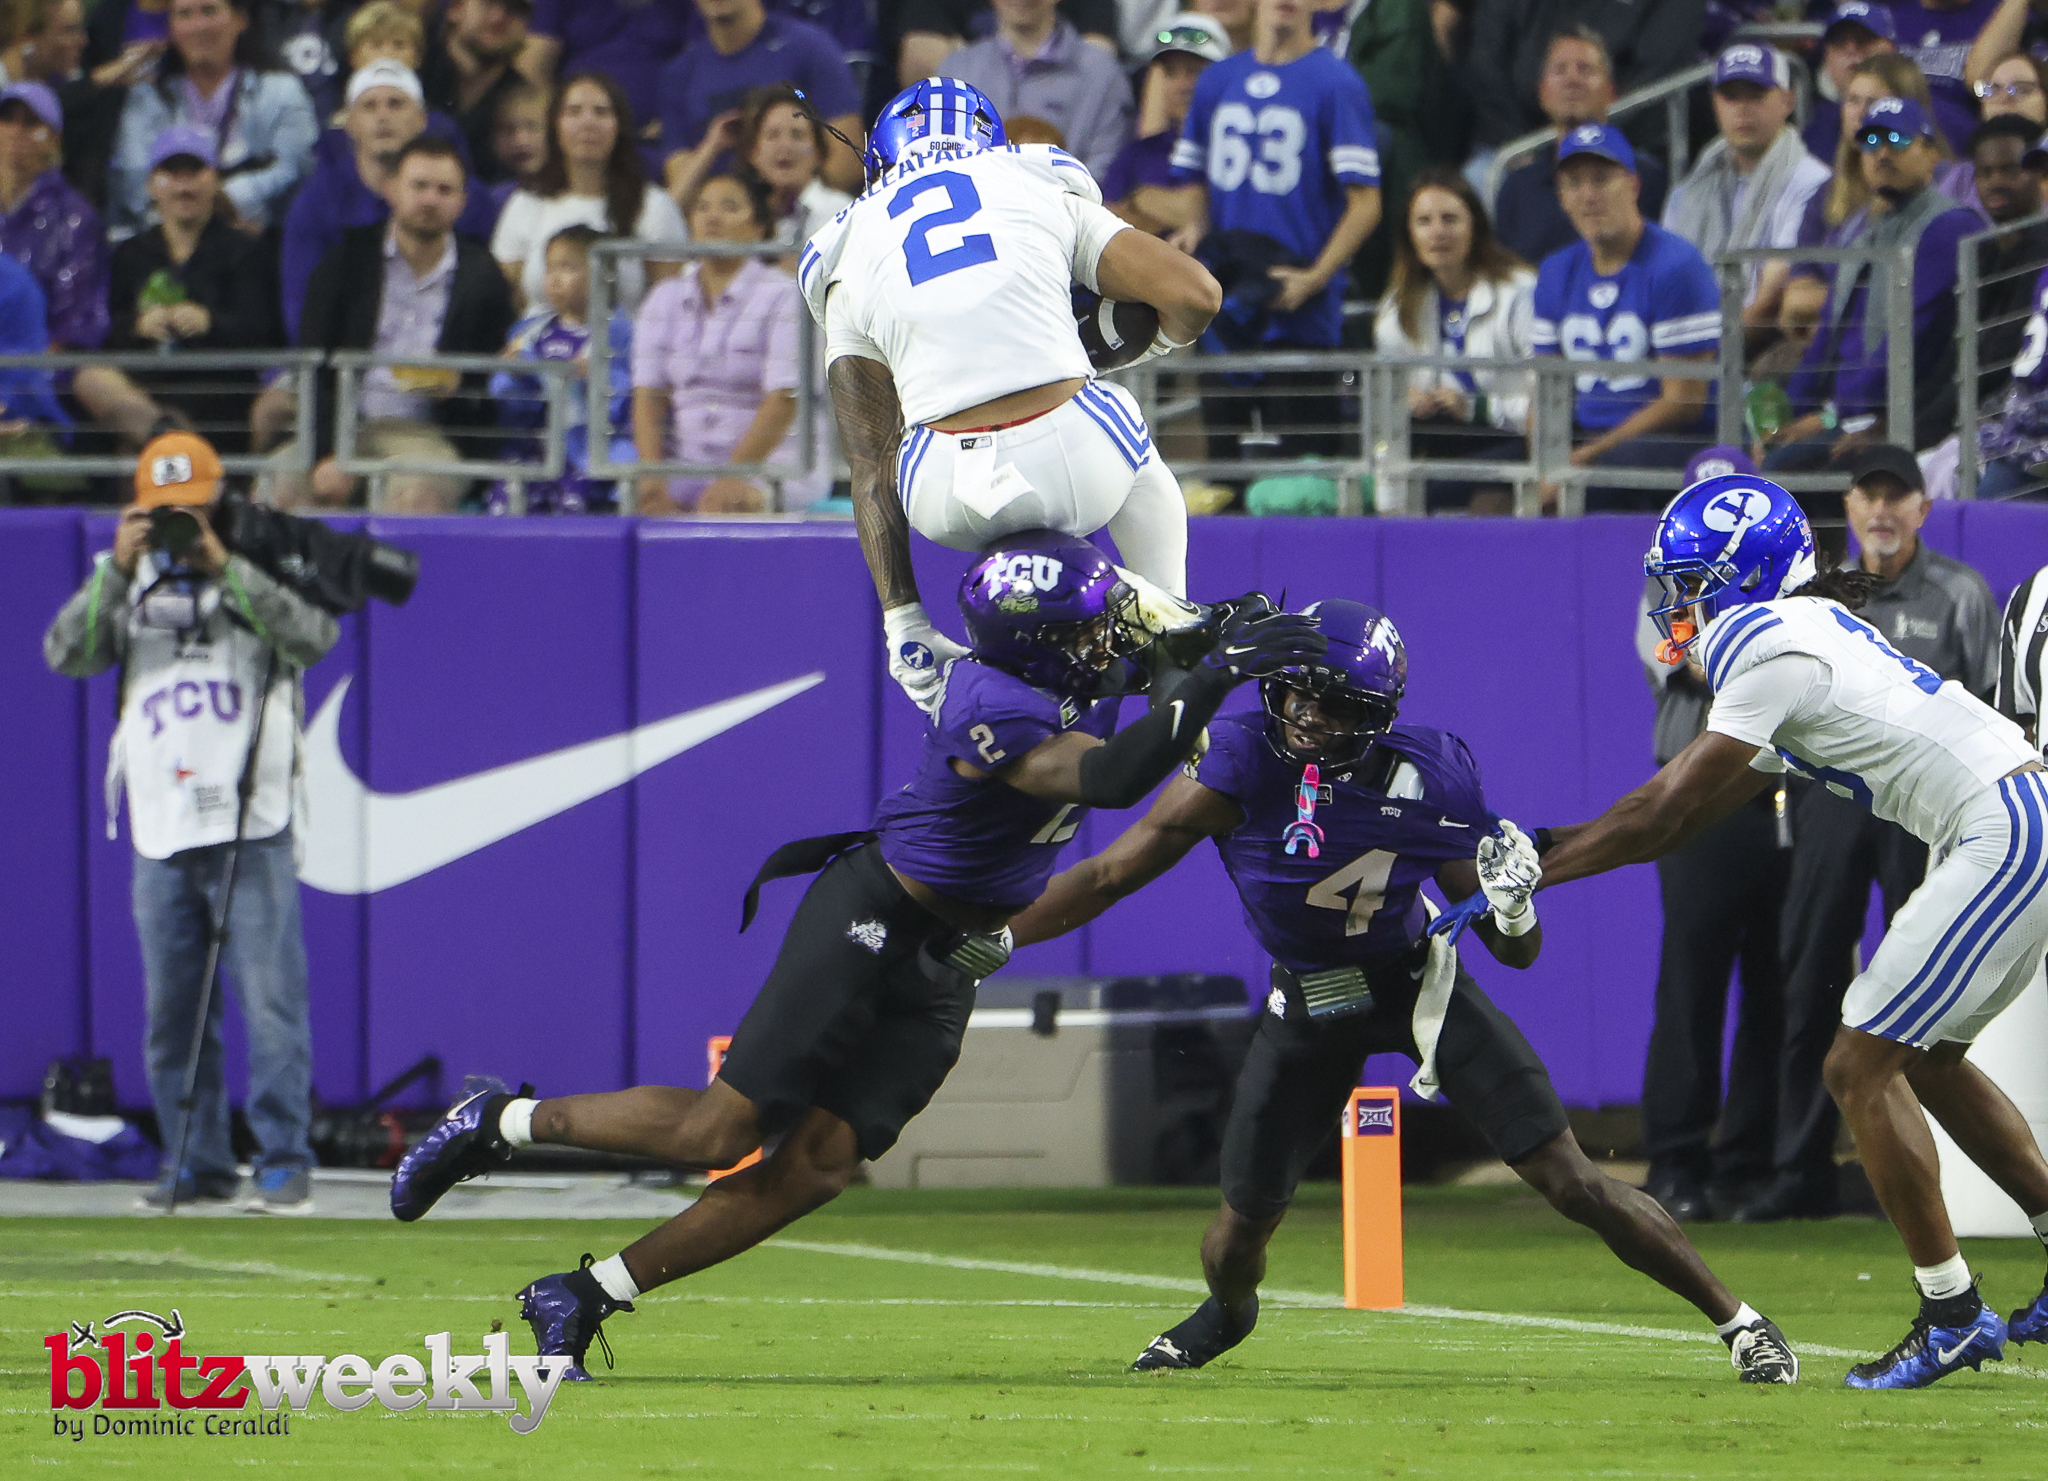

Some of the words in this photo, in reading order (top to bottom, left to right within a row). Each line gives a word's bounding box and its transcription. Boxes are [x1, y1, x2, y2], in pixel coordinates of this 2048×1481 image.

[911, 126, 920, 137] 2
[1208, 104, 1307, 195] 63
[886, 170, 998, 287] 2
[983, 554, 1063, 601] TCU
[1371, 616, 1405, 666] TC
[143, 680, 241, 738] TCU
[968, 723, 1007, 764] 2
[1380, 806, 1402, 818] TCU
[1305, 848, 1398, 937] 4
